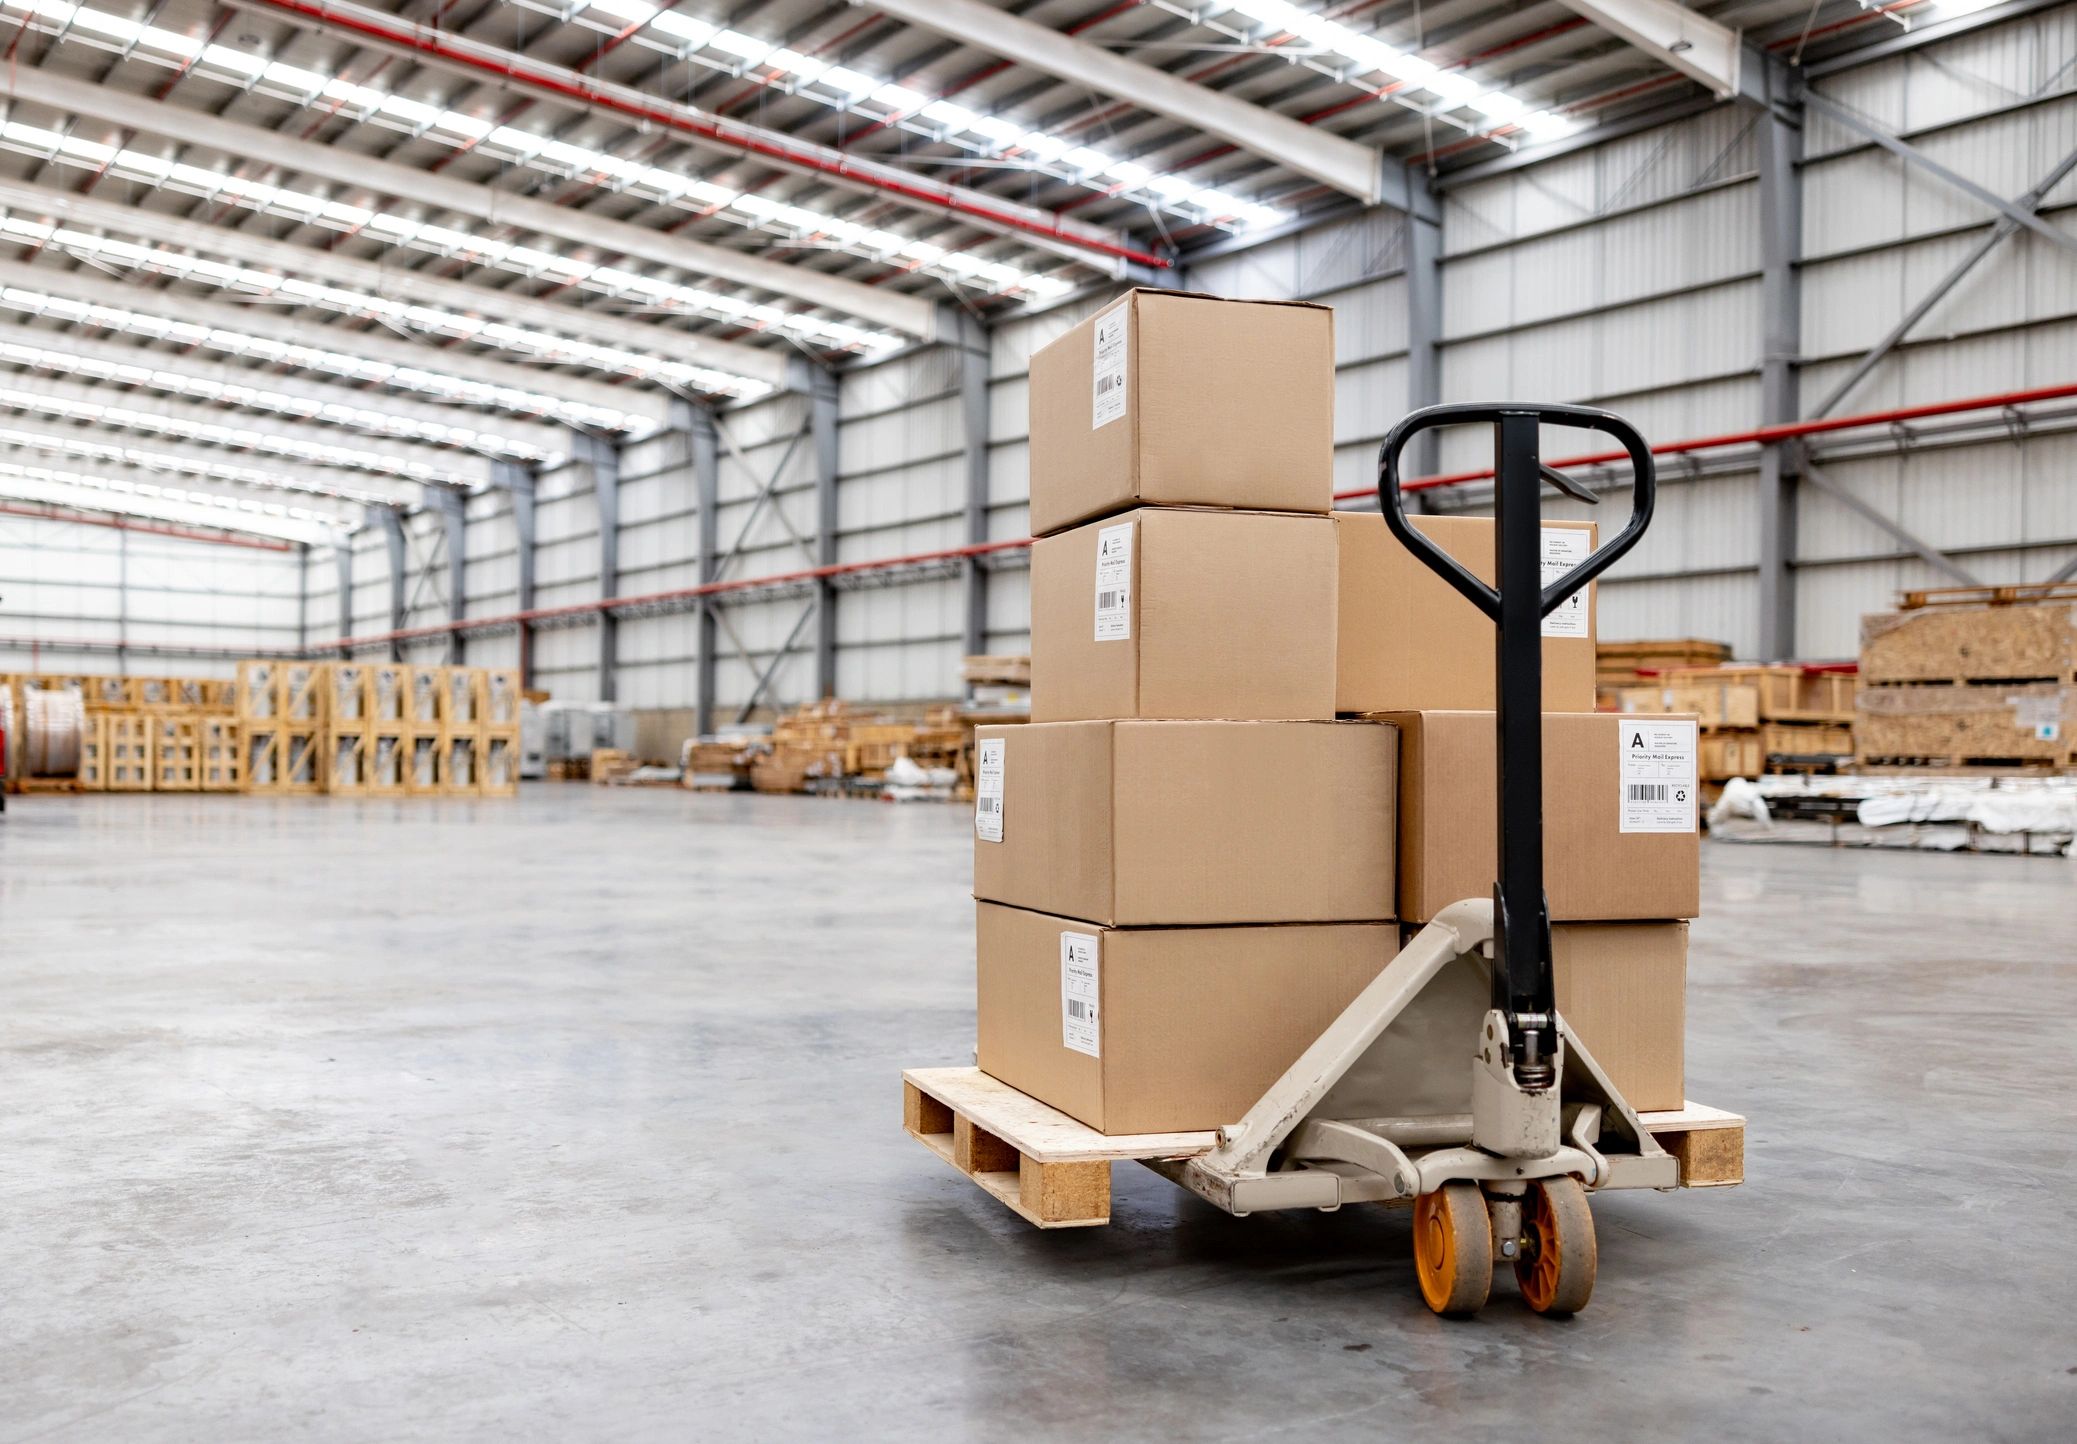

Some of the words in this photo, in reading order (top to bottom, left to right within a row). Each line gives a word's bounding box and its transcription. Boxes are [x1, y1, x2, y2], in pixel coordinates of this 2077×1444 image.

[1099, 328, 1105, 345] A
[1102, 540, 1108, 556] A
[1631, 732, 1645, 748] A
[983, 750, 988, 765] A
[1631, 753, 1651, 761] Priority
[1068, 945, 1074, 962] A
